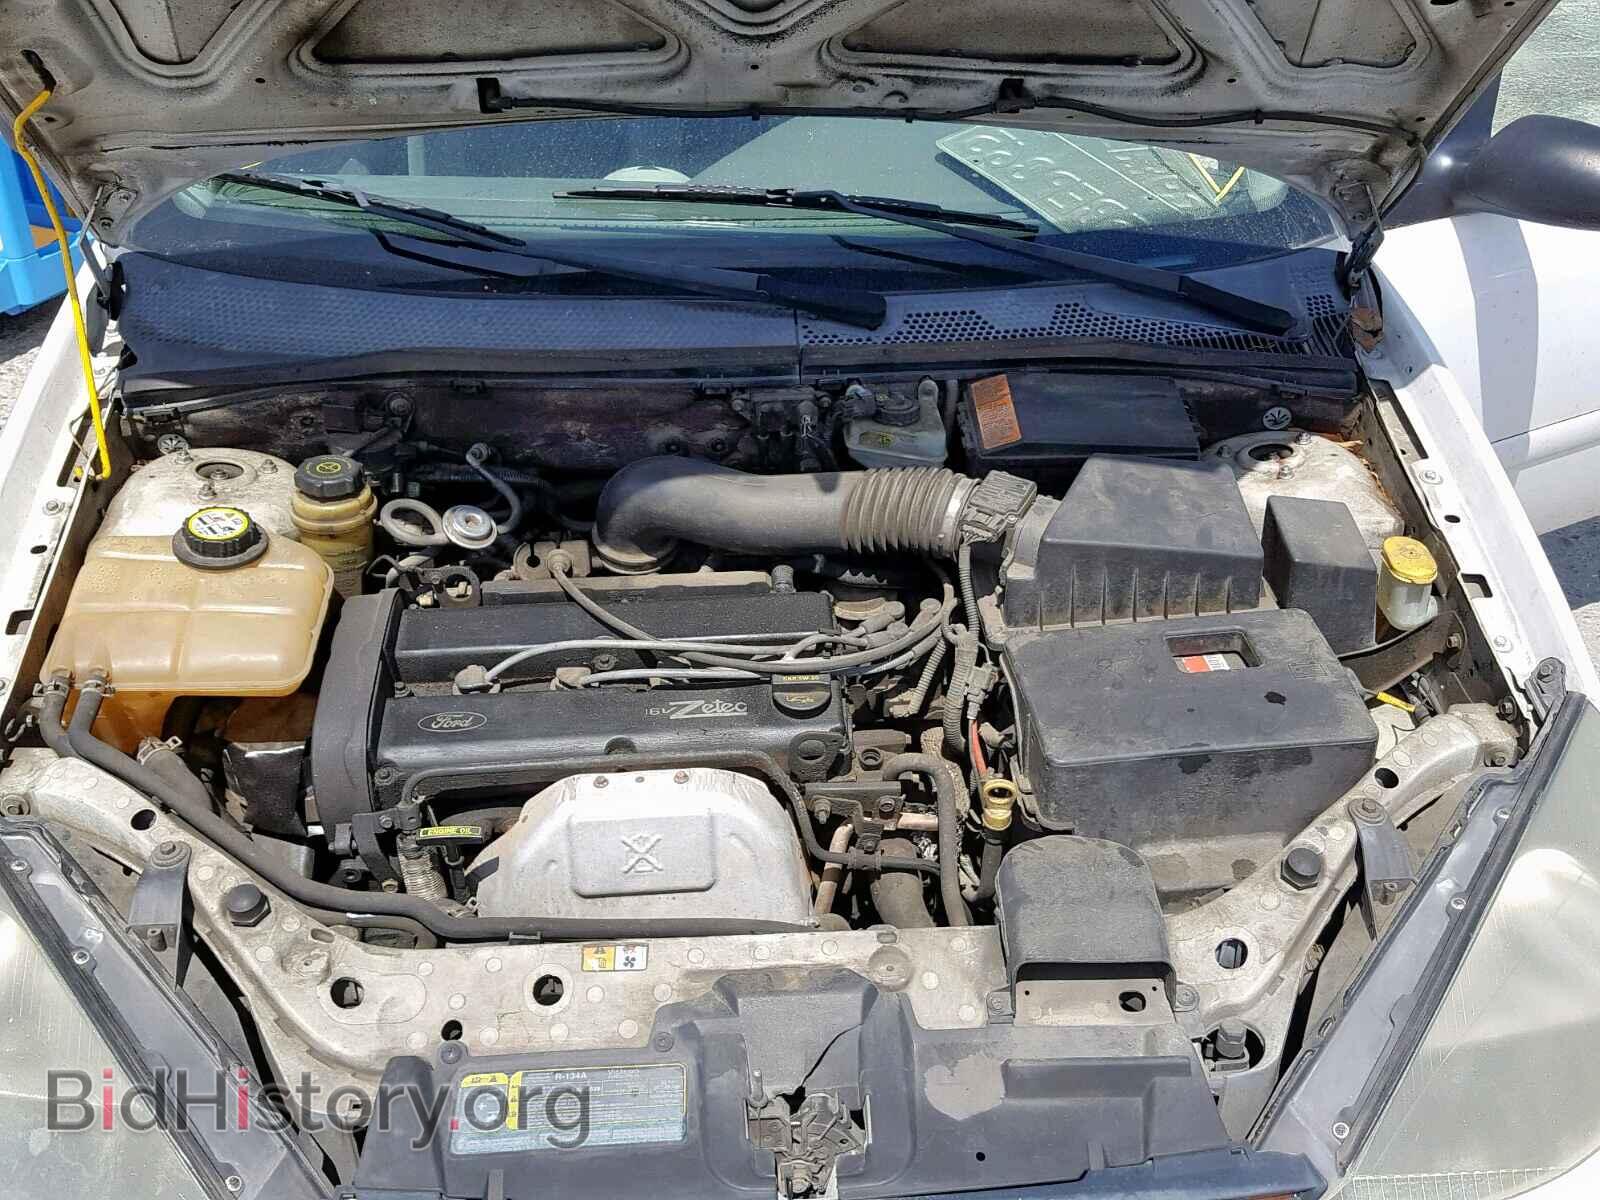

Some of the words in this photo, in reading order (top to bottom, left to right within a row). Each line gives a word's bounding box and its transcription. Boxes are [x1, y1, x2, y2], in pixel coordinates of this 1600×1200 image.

[645, 706, 677, 716] 16V
[669, 699, 748, 720] Zetec
[431, 713, 475, 729] Ford
[428, 827, 457, 835] ENGINE
[554, 1071, 588, 1081] R-134A
